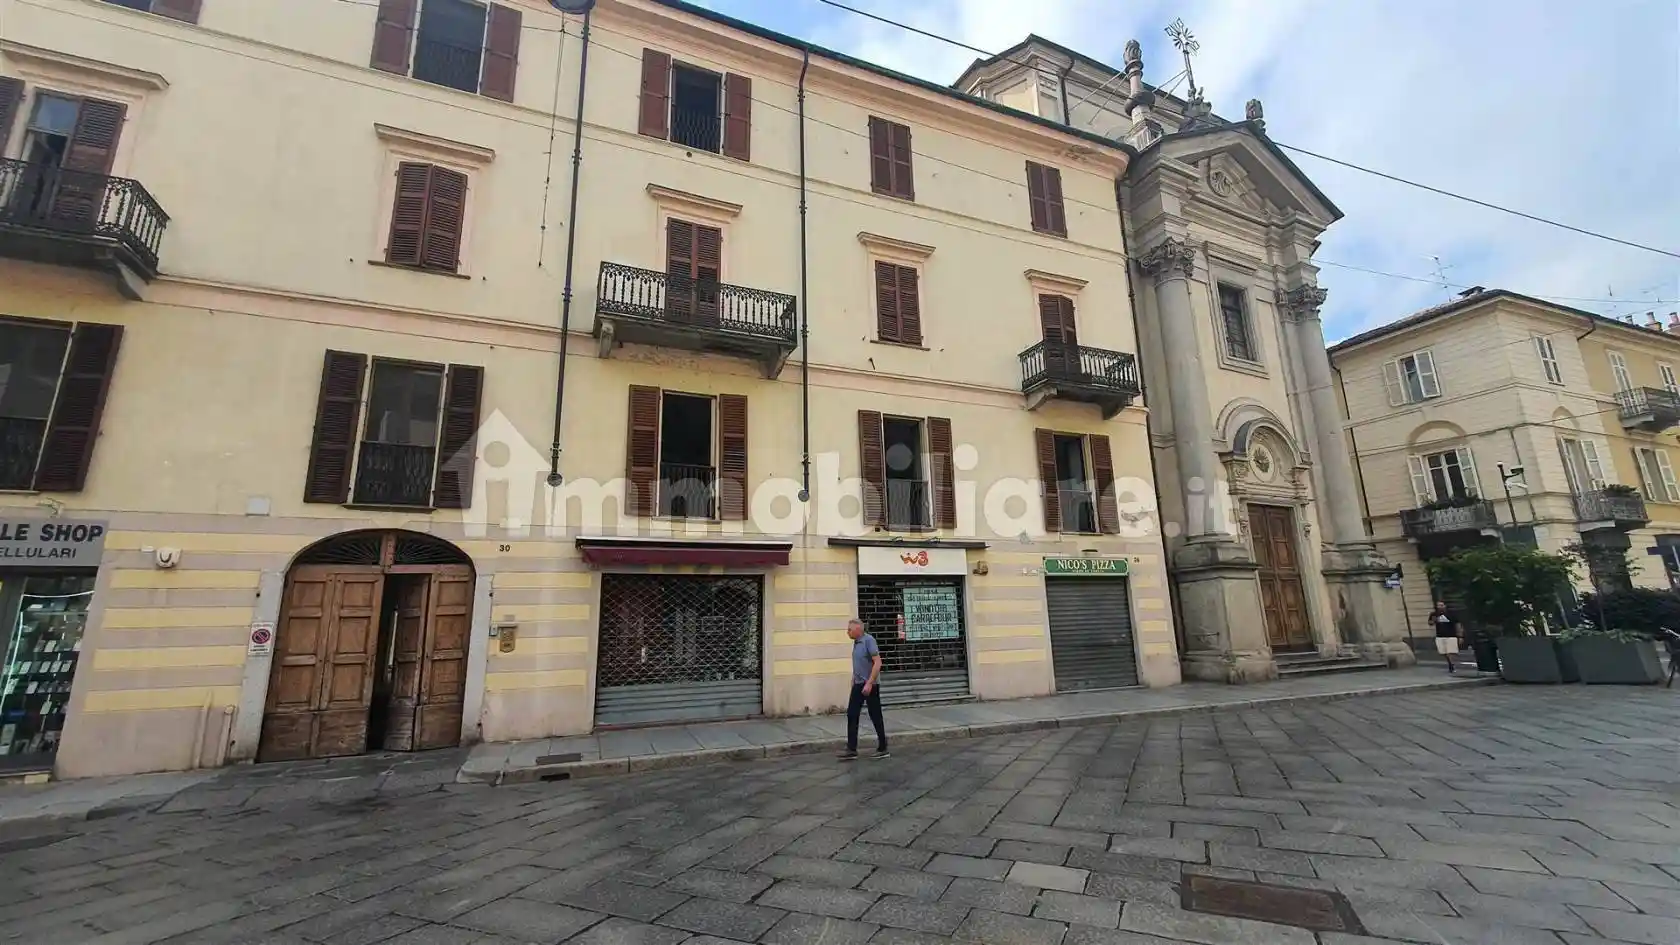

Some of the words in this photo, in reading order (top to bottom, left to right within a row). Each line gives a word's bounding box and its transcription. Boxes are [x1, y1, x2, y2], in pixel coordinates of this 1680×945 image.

[40, 523, 104, 542] SHOP
[499, 544, 511, 552] 30
[1057, 559, 1088, 570] NICO'S
[1091, 559, 1117, 570] PIZZA
